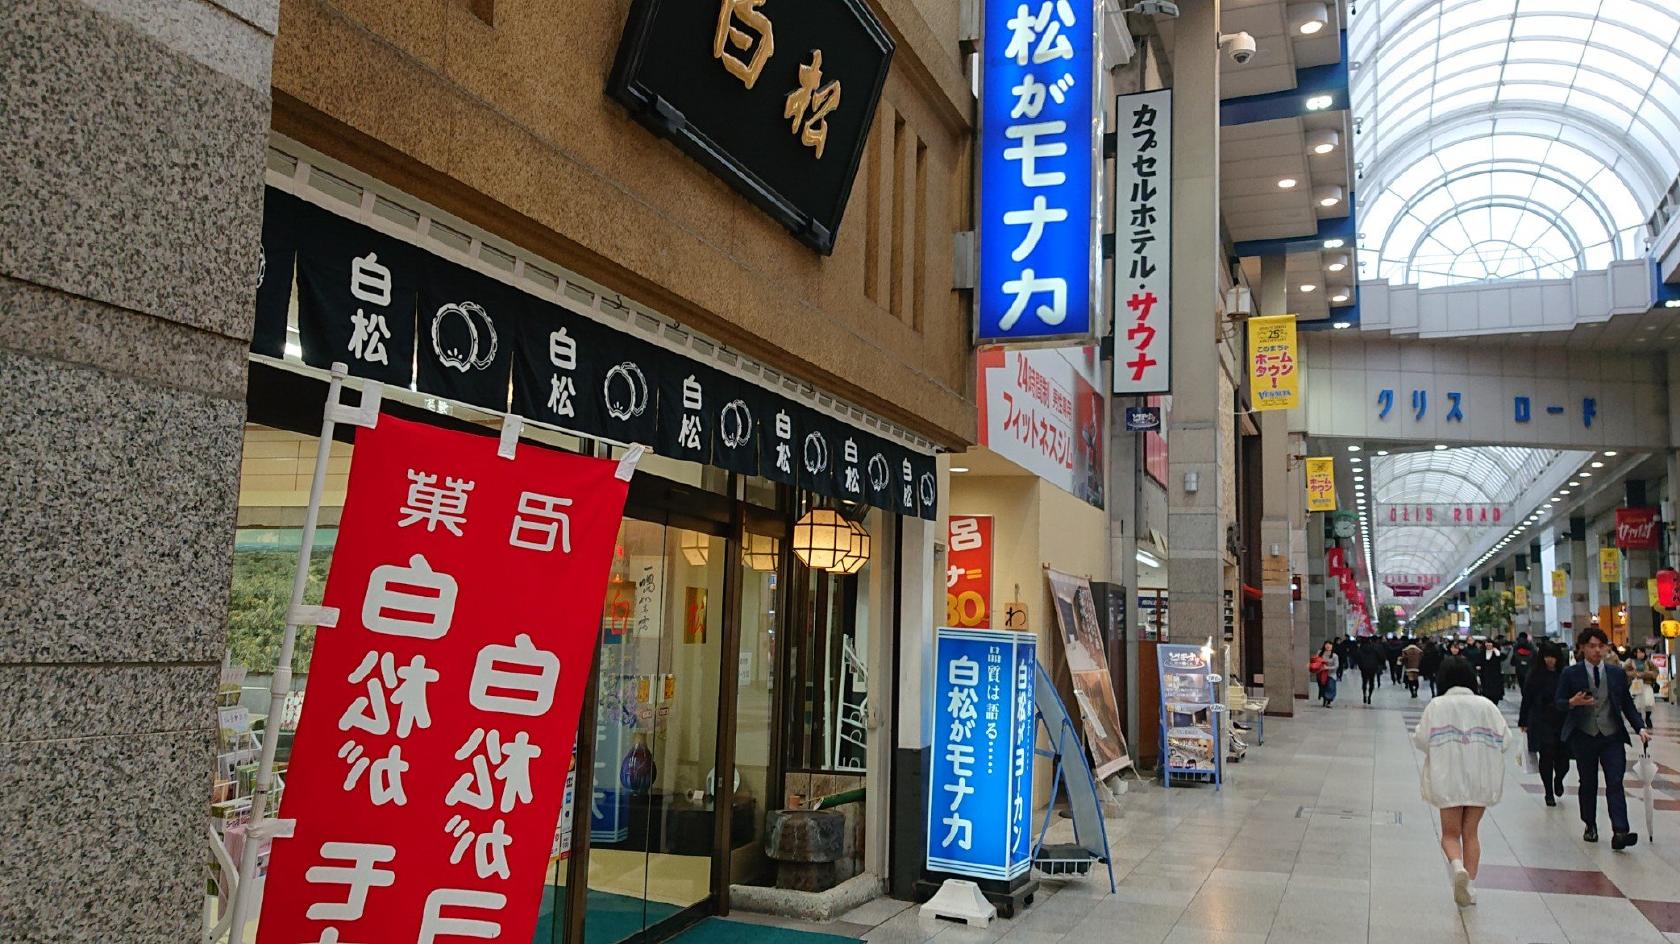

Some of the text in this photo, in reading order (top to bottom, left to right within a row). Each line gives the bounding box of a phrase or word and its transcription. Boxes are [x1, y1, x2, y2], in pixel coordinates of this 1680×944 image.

[998, 0, 1076, 331] 松がモナカ
[347, 251, 392, 366] 白松
[547, 326, 577, 418] 白松
[1255, 352, 1293, 364] ホーム
[1256, 365, 1293, 377] タウン
[678, 374, 703, 450] 白松
[774, 408, 792, 474] 白松
[1003, 391, 1073, 470] フィットネスジム
[1377, 388, 1597, 428] クリス ロード
[844, 437, 860, 494] 白松
[902, 457, 914, 508] 白松
[1453, 507, 1502, 523] ROAD
[941, 655, 980, 851] 白松がモナカ
